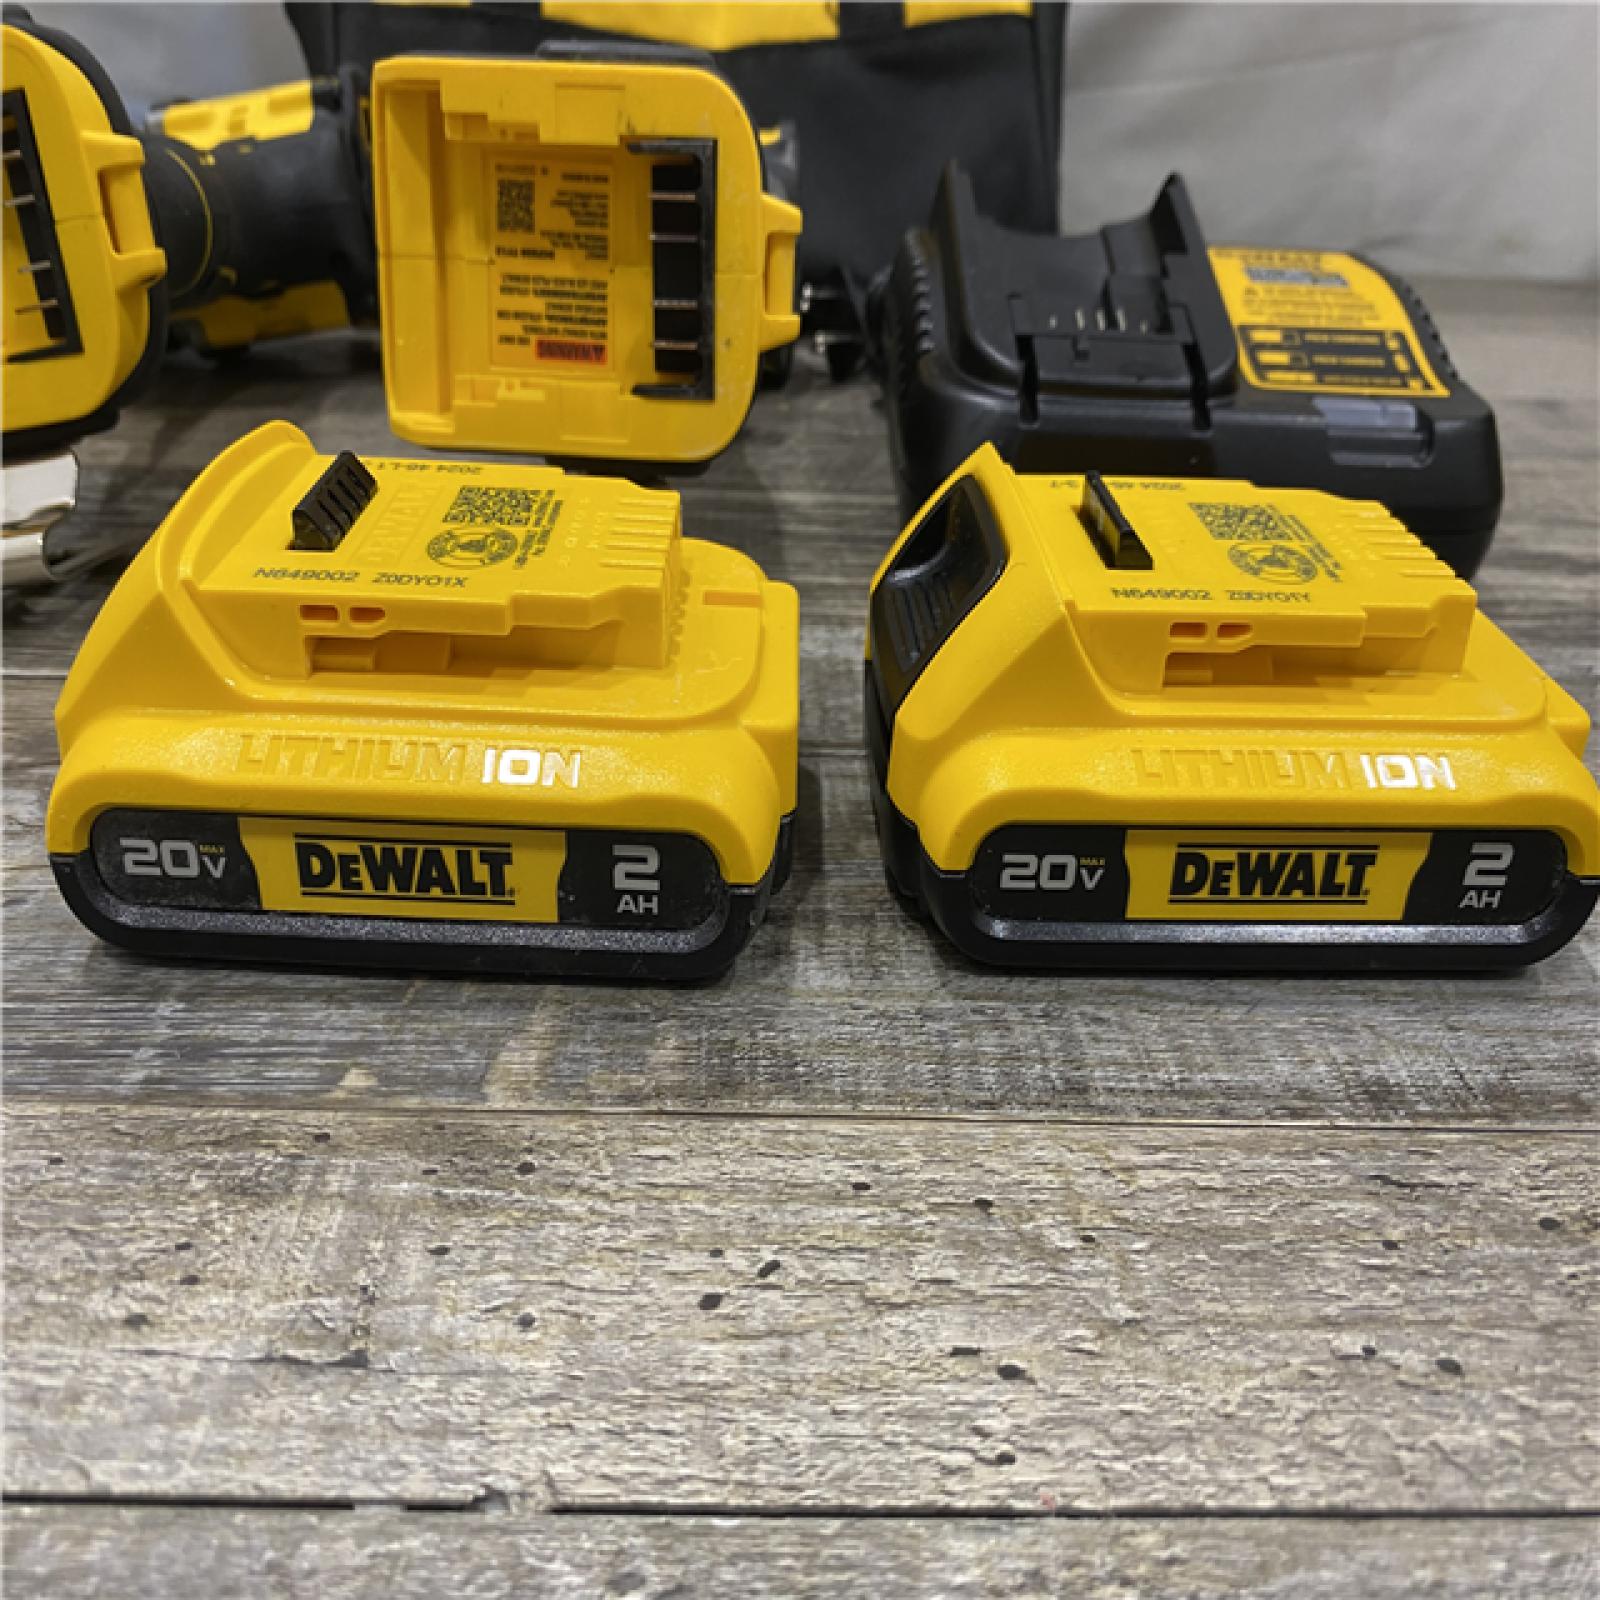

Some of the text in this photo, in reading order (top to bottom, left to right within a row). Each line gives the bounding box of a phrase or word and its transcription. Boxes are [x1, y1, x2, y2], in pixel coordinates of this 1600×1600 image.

[234, 733, 583, 789] LITHIUM ION
[1130, 749, 1457, 790] LITHIUM ION
[611, 844, 661, 891] 2
[1462, 841, 1515, 886] 2
[616, 894, 659, 915] AH
[1458, 889, 1502, 909] AH
